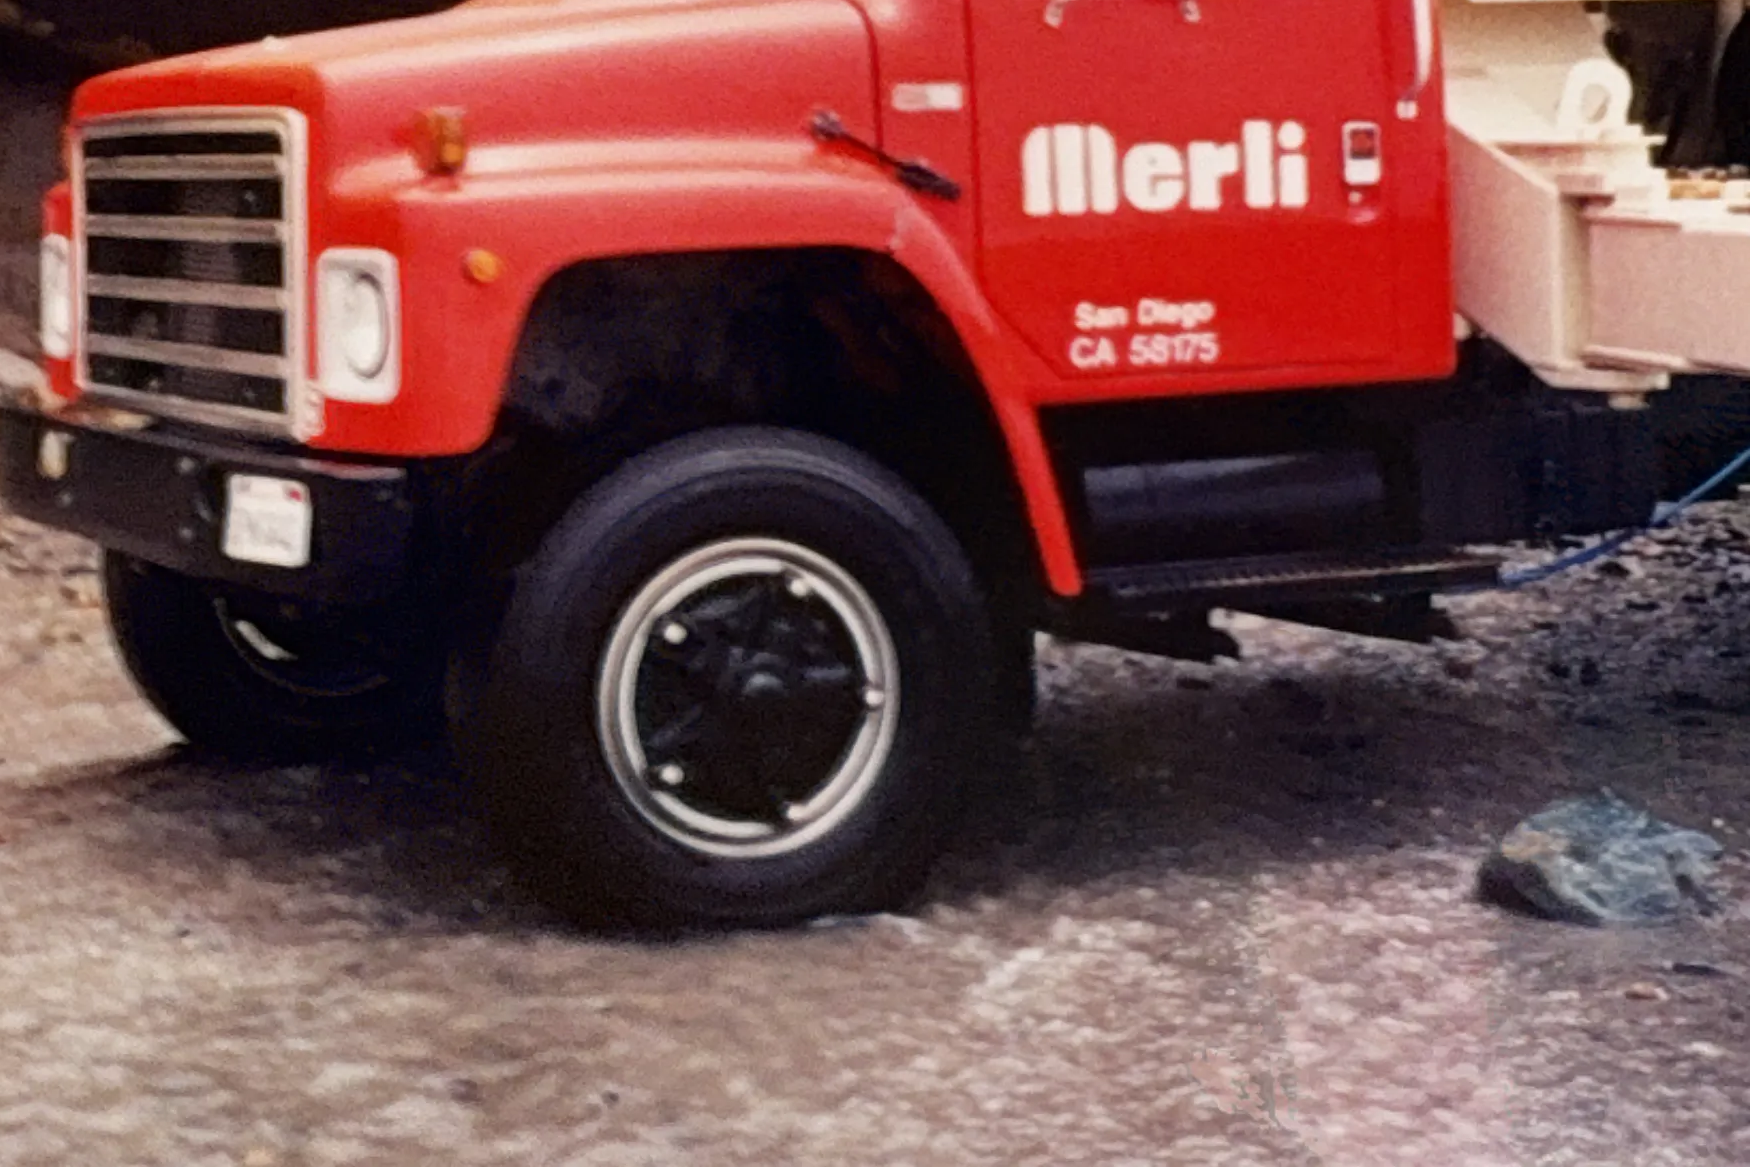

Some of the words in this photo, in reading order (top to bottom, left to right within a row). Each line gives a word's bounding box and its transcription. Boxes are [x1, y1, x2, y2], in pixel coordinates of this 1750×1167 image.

[1022, 119, 1308, 215] Merli
[1074, 301, 1129, 330] San
[1137, 297, 1216, 329] Diego
[1069, 335, 1117, 369] CA
[1129, 331, 1220, 366] 58175
